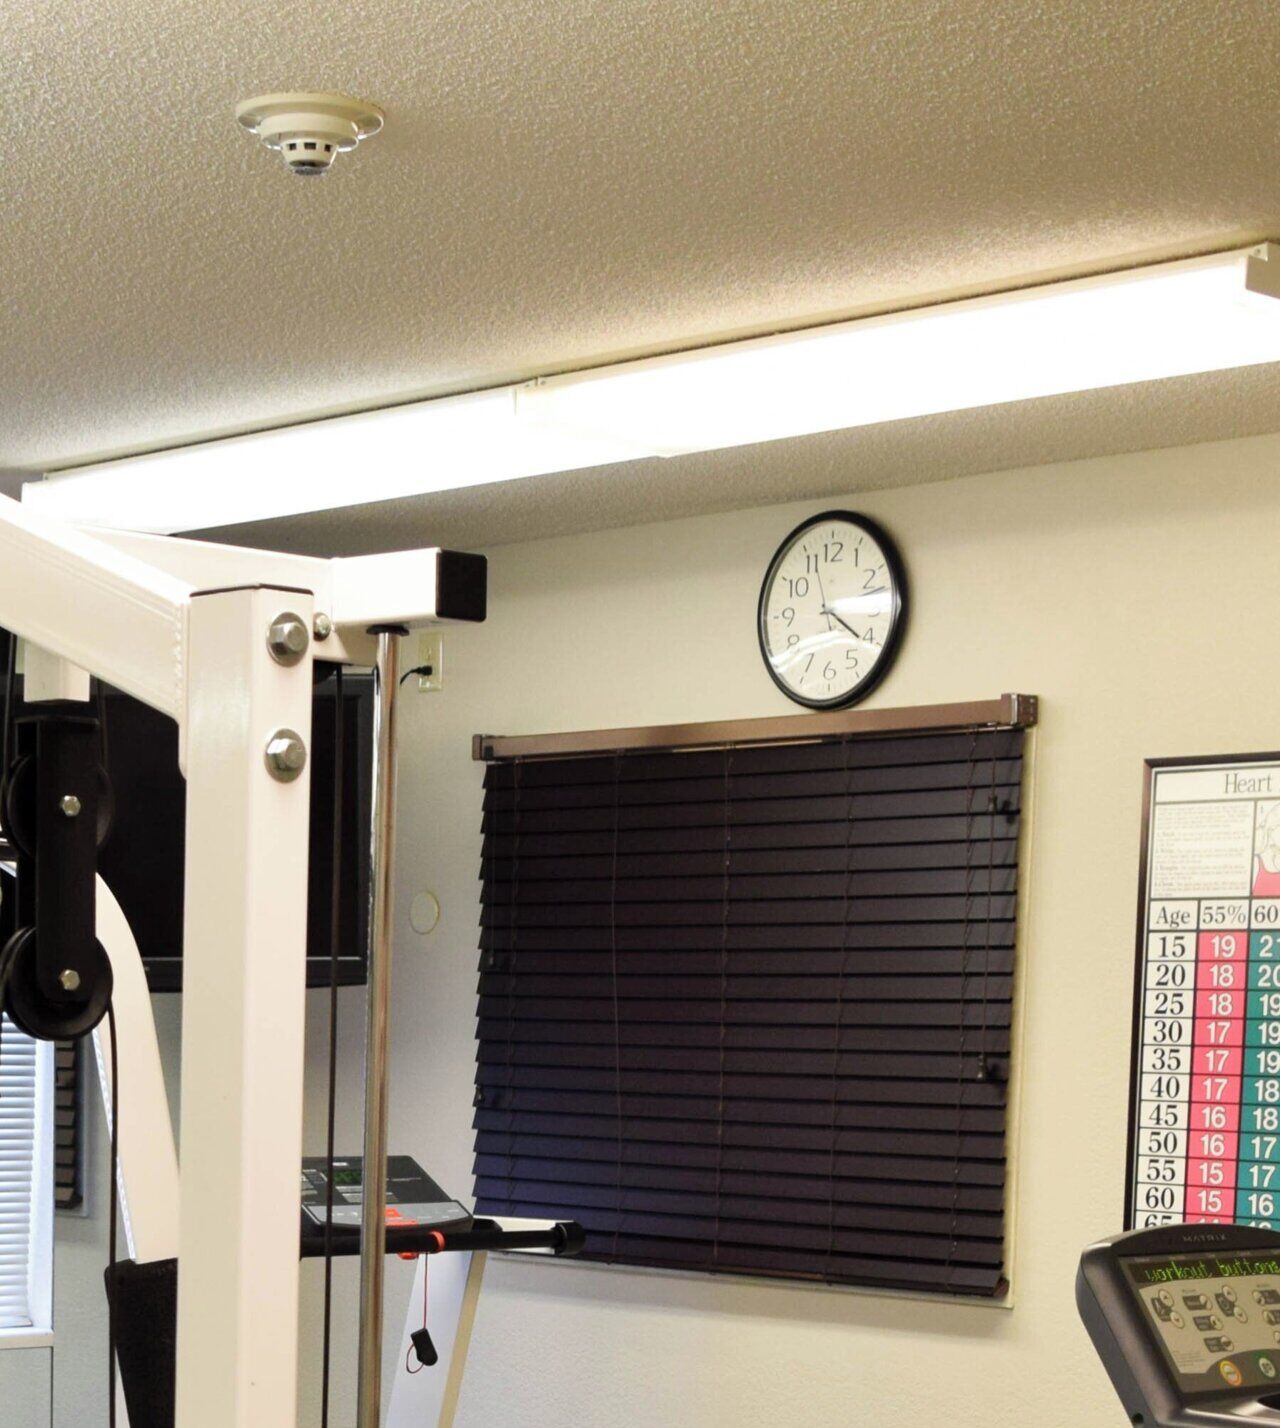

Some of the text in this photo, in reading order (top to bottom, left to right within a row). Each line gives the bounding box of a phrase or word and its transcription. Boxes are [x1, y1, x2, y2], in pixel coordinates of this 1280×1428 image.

[824, 542, 844, 563] 12
[854, 548, 859, 567] 1
[806, 554, 818, 574] 11
[789, 577, 809, 598] 10
[863, 569, 876, 589] 2
[781, 607, 795, 627] 9
[862, 627, 874, 644] 4
[805, 653, 815, 672] 7
[845, 649, 858, 669] 5
[823, 661, 837, 680] 6
[1223, 772, 1271, 794] Heart
[1156, 905, 1190, 928] Age
[1202, 905, 1246, 925] 55%
[1160, 936, 1186, 958] 15
[1212, 935, 1235, 958] 19
[1156, 964, 1185, 986] 20
[1210, 964, 1233, 987] 18
[1154, 992, 1183, 1014] 25
[1209, 993, 1232, 1016] 18
[1153, 1021, 1182, 1043] 30
[1208, 1021, 1230, 1043] 17
[1152, 1049, 1181, 1070] 35
[1206, 1050, 1229, 1072] 17
[1257, 1051, 1280, 1073] 19
[1151, 1076, 1180, 1098] 40
[1204, 1078, 1227, 1100] 17
[1255, 1080, 1279, 1102] 18
[1150, 1103, 1178, 1125] 45
[1203, 1106, 1225, 1128] 16
[1253, 1108, 1278, 1130] 18
[1149, 1131, 1177, 1154] 50
[1201, 1134, 1224, 1156] 16
[1252, 1137, 1276, 1158] 17
[1146, 1159, 1175, 1181] 55
[1200, 1162, 1223, 1184] 15
[1250, 1165, 1275, 1187] 17
[1145, 1187, 1174, 1209] 60
[1199, 1190, 1221, 1212] 15
[1249, 1194, 1273, 1216] 16
[1183, 1233, 1227, 1243] MATRIX
